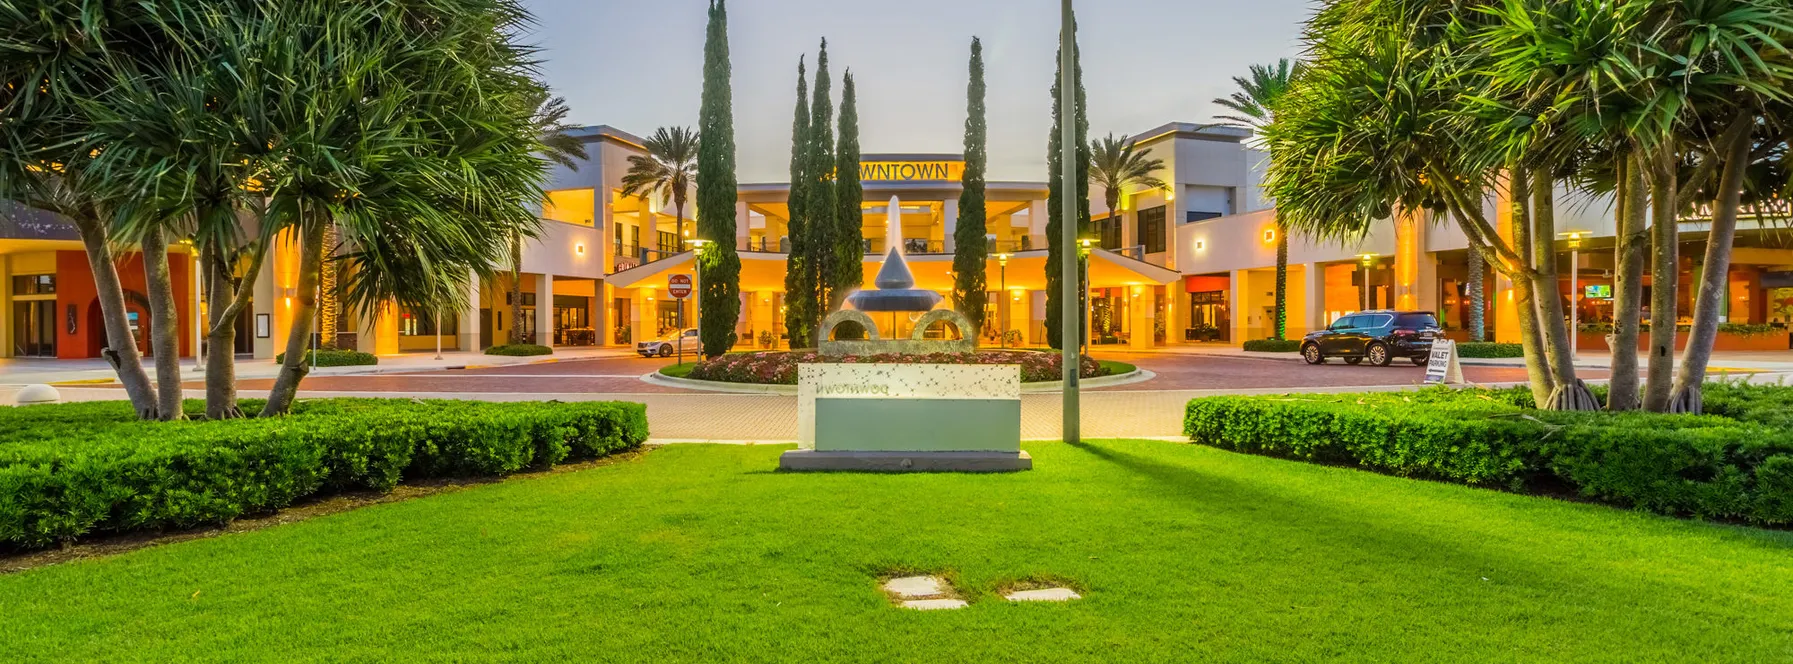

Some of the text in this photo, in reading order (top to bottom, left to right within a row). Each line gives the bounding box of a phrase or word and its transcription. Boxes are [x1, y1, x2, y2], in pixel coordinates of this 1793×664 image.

[859, 163, 948, 180] WNTOWN
[1431, 351, 1449, 359] VALET
[1429, 360, 1447, 368] PARKING
